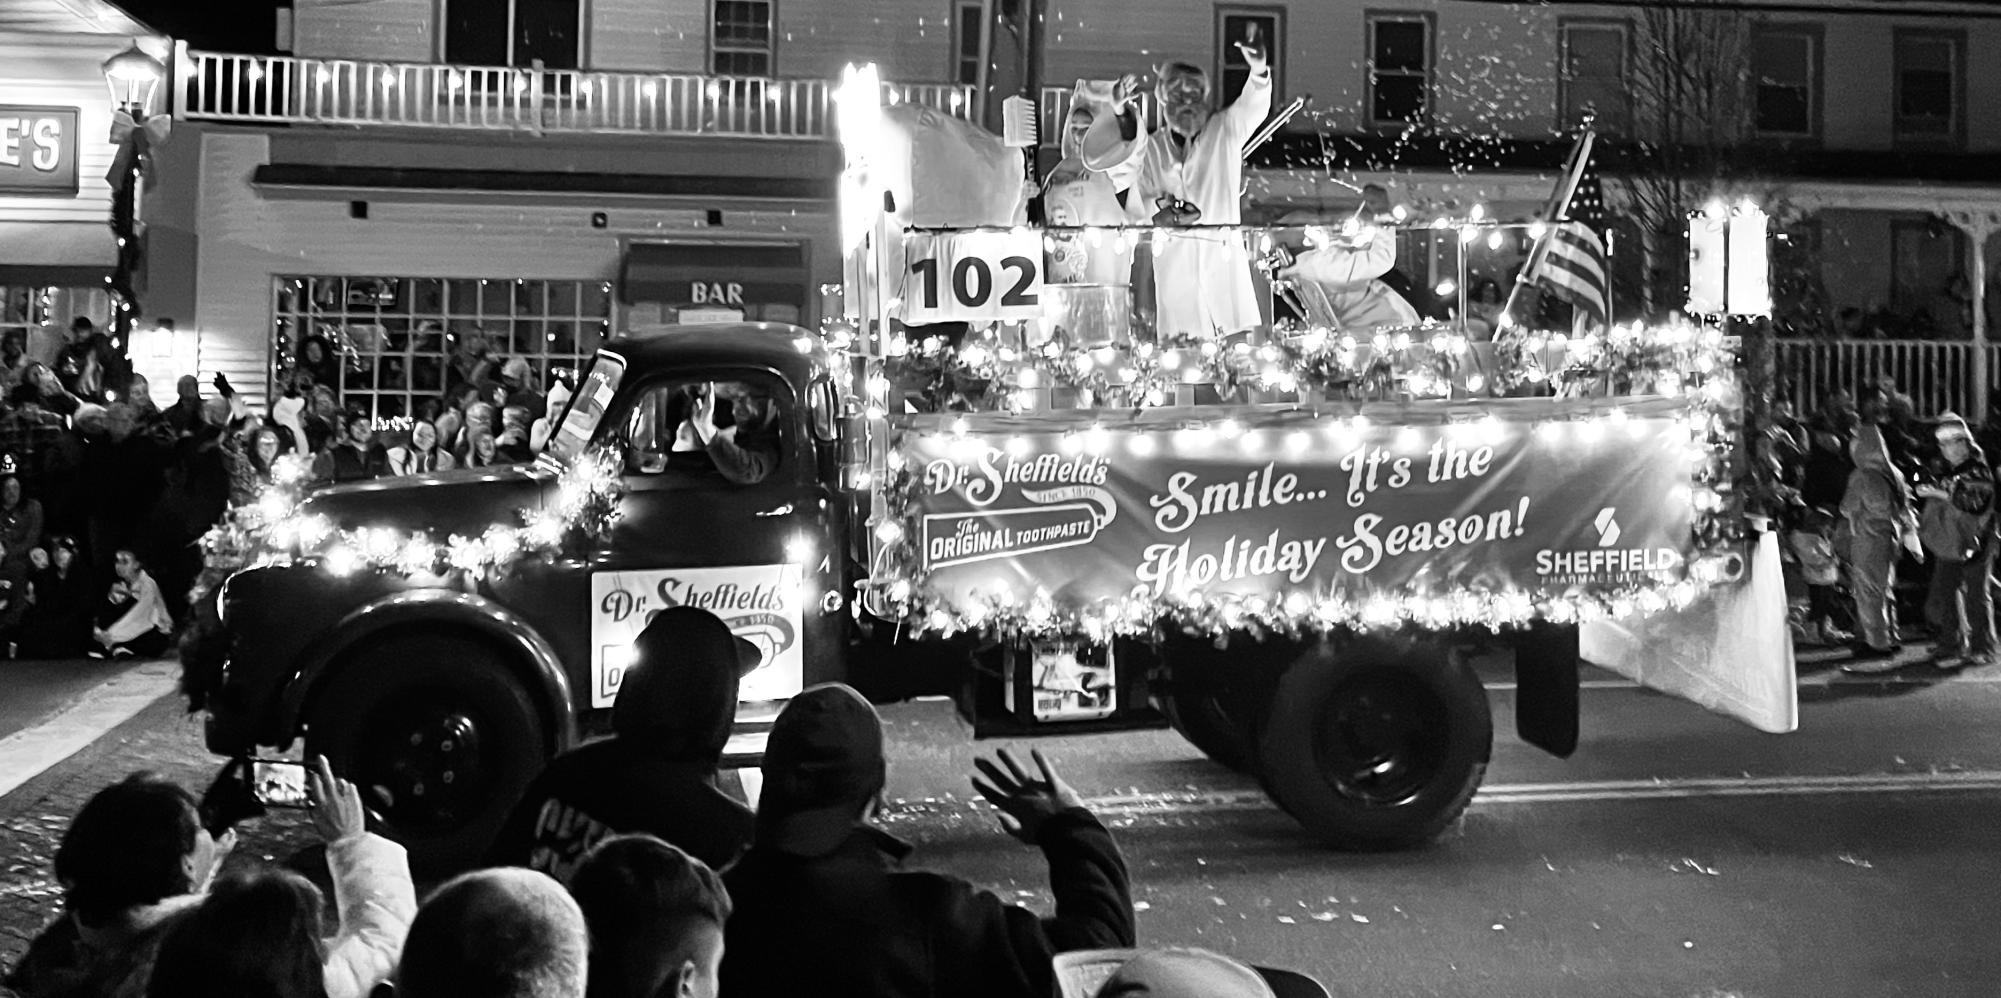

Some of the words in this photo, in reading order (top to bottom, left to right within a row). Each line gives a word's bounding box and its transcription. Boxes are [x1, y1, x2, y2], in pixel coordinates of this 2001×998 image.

[692, 282, 744, 304] BAR
[911, 256, 1039, 308] 102
[923, 459, 969, 495] Dr.
[1150, 461, 1327, 533] Smile...
[1340, 442, 1411, 507] It's
[1428, 437, 1493, 483] the
[930, 528, 1014, 560] ORIGINAL
[1016, 520, 1091, 545] TOOTHPASTE
[956, 518, 980, 539] The
[1131, 528, 1326, 600] Holiday
[1336, 496, 1530, 573] Season!
[1536, 548, 1676, 575] SHEFFIELD
[601, 589, 646, 622] Dr.
